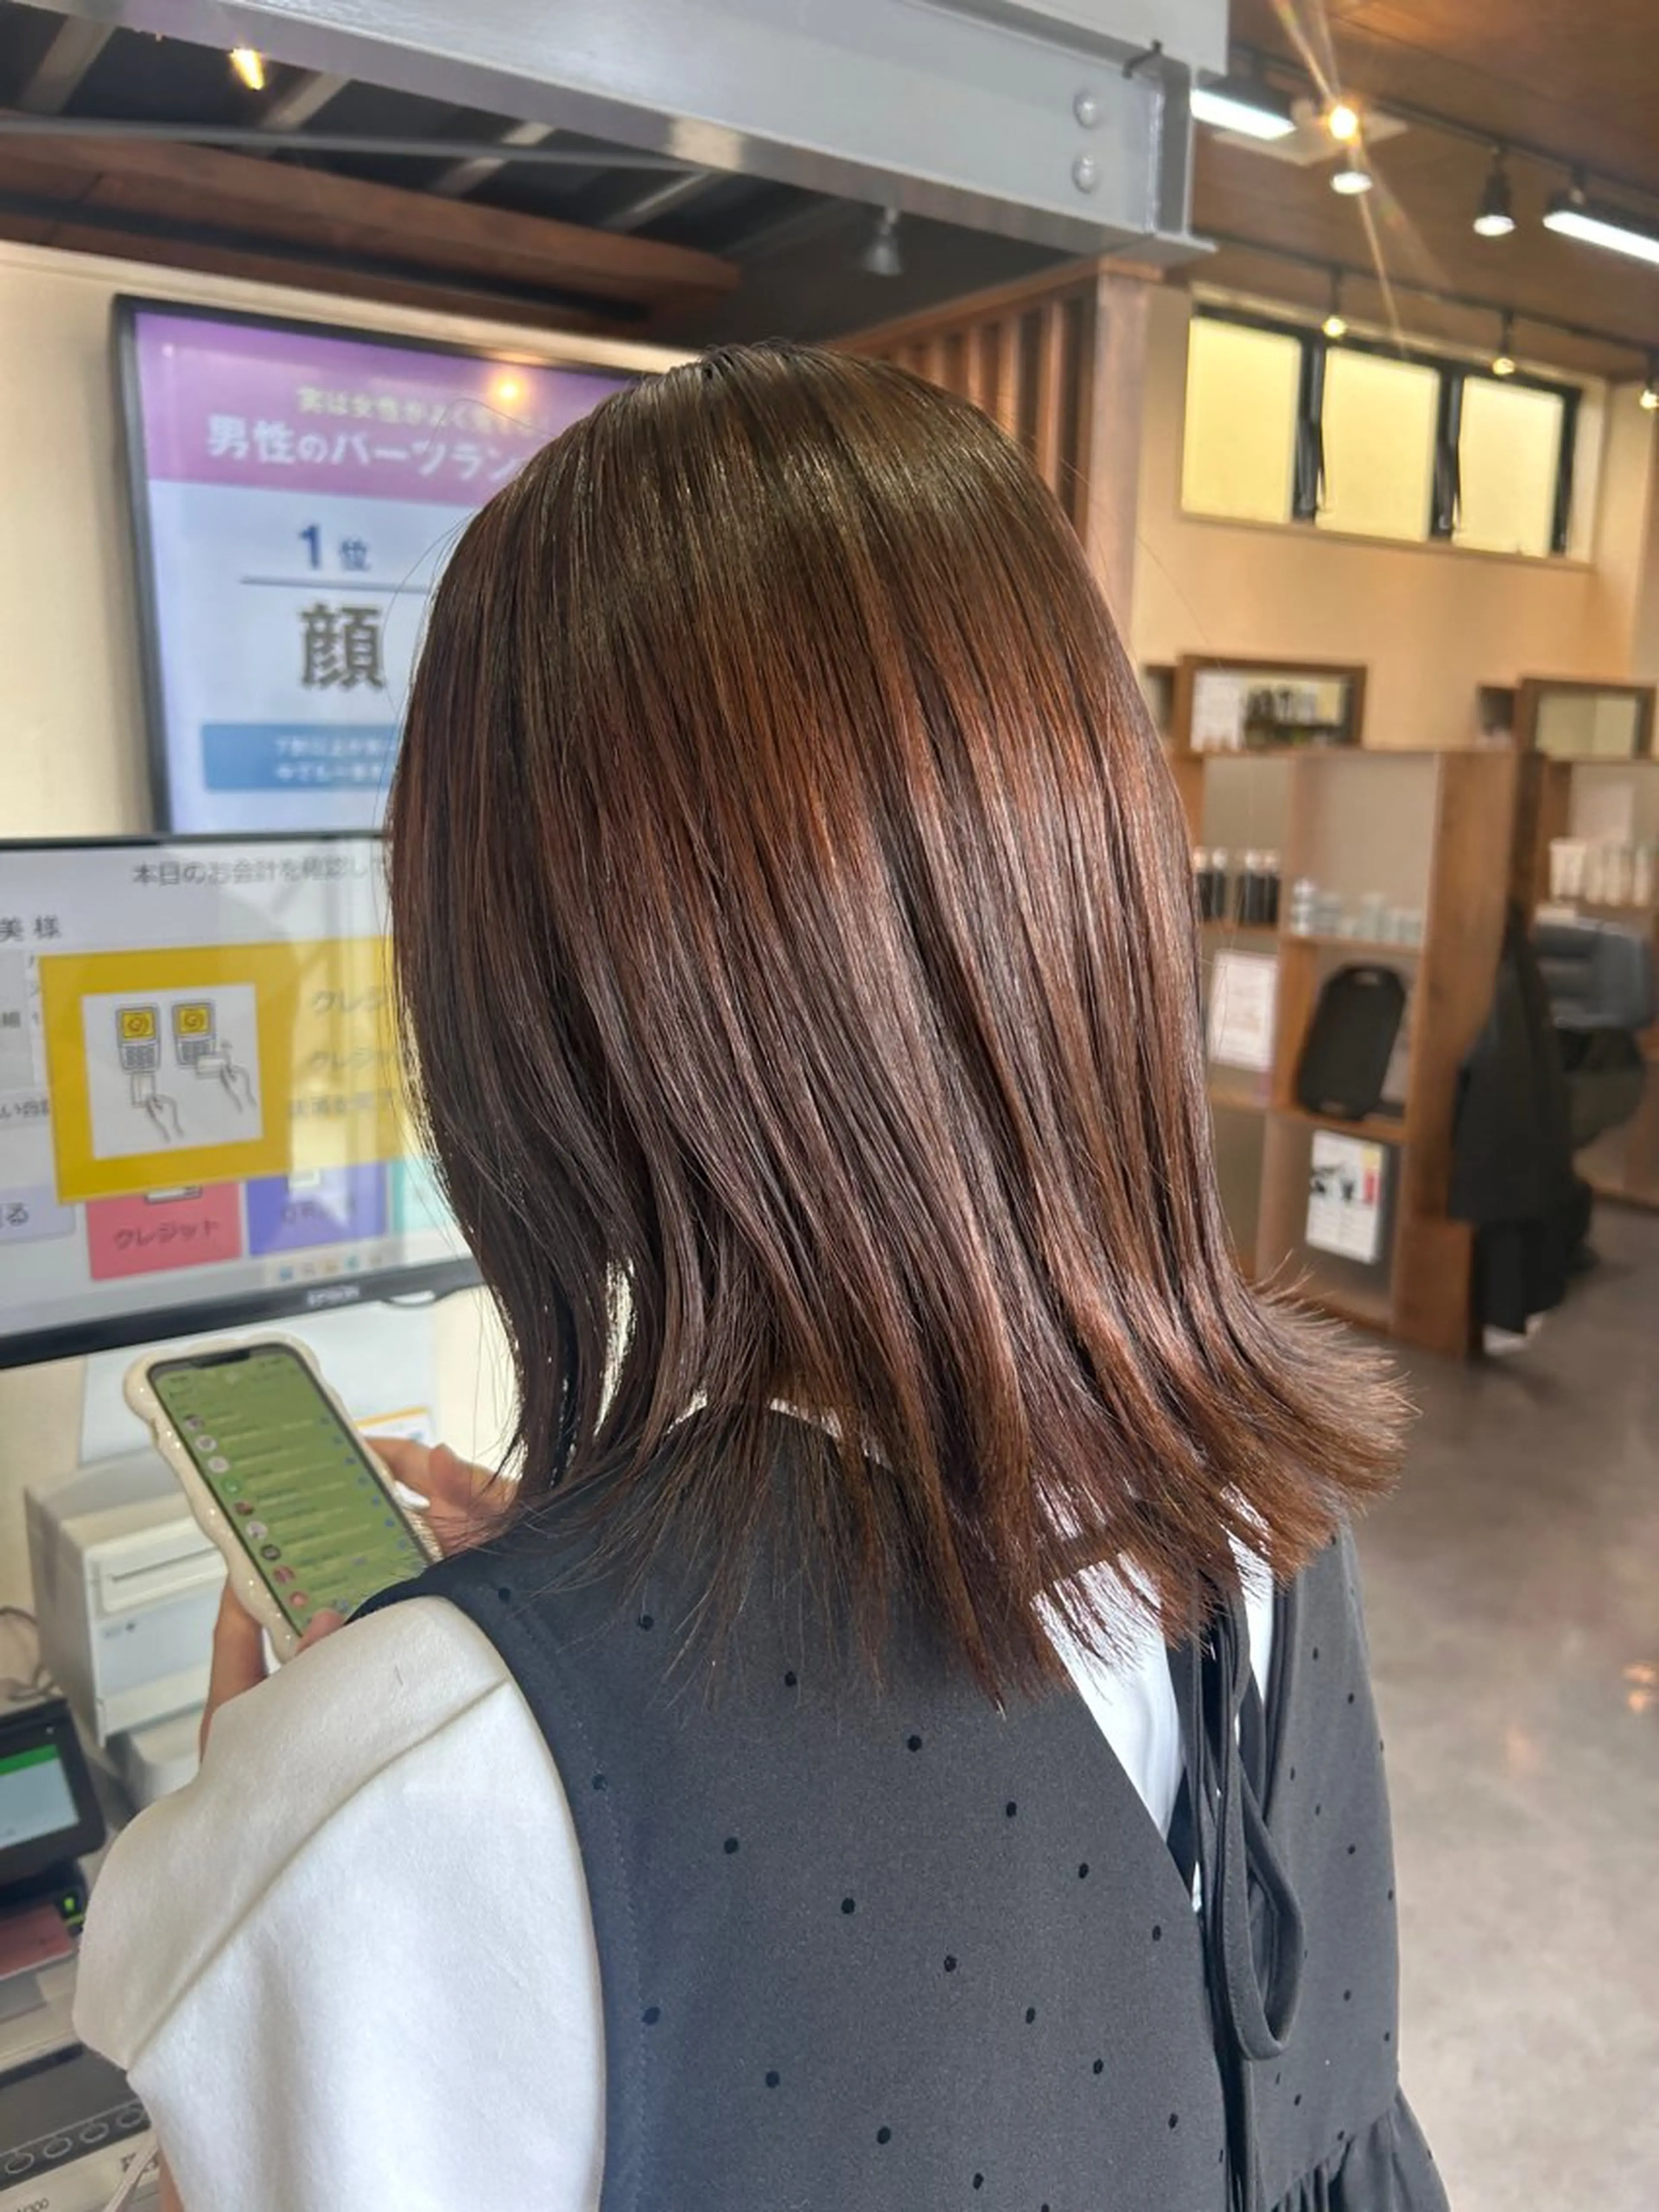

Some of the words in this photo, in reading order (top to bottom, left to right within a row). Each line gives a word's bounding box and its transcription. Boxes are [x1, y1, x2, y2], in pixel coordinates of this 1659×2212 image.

[299, 524, 371, 572] 1位
[299, 604, 385, 690] 顔
[113, 1218, 221, 1250] クレジット
